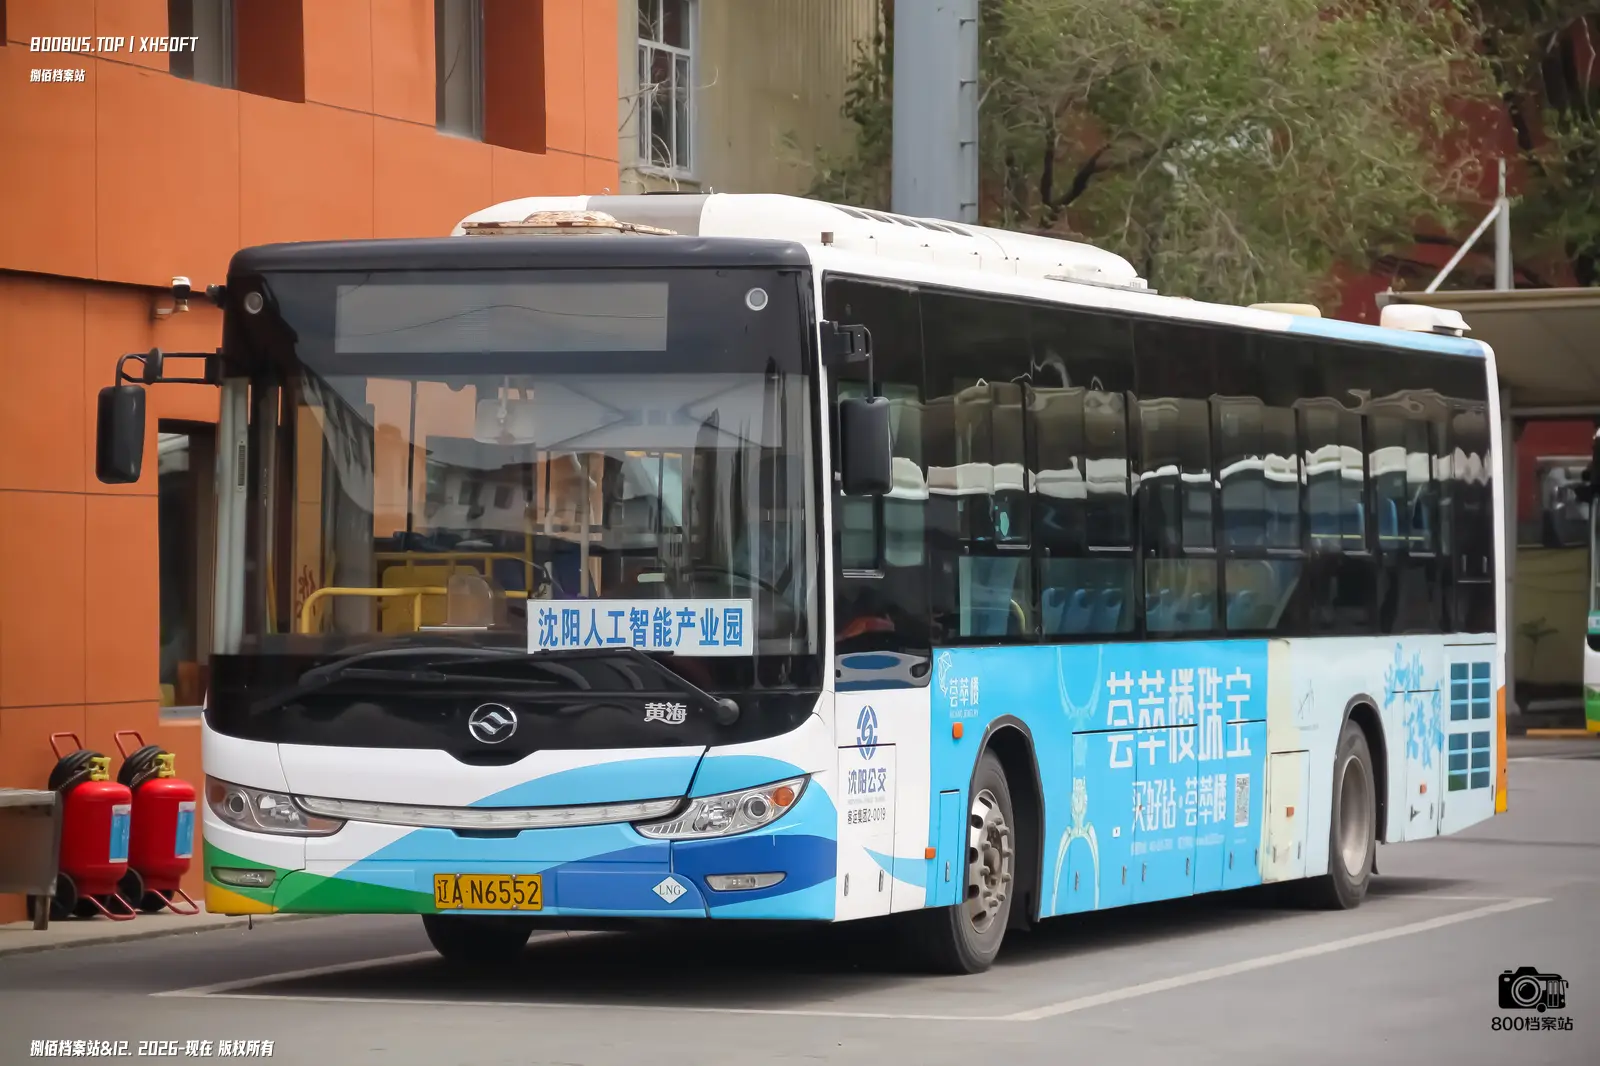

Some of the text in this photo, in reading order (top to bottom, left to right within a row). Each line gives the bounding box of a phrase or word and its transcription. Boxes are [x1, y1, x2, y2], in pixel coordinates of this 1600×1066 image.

[538, 607, 743, 647] 沈阳人工智能产业园
[644, 702, 687, 725] 黄海
[847, 767, 887, 795] 沈阳公交
[659, 884, 681, 896] LNG
